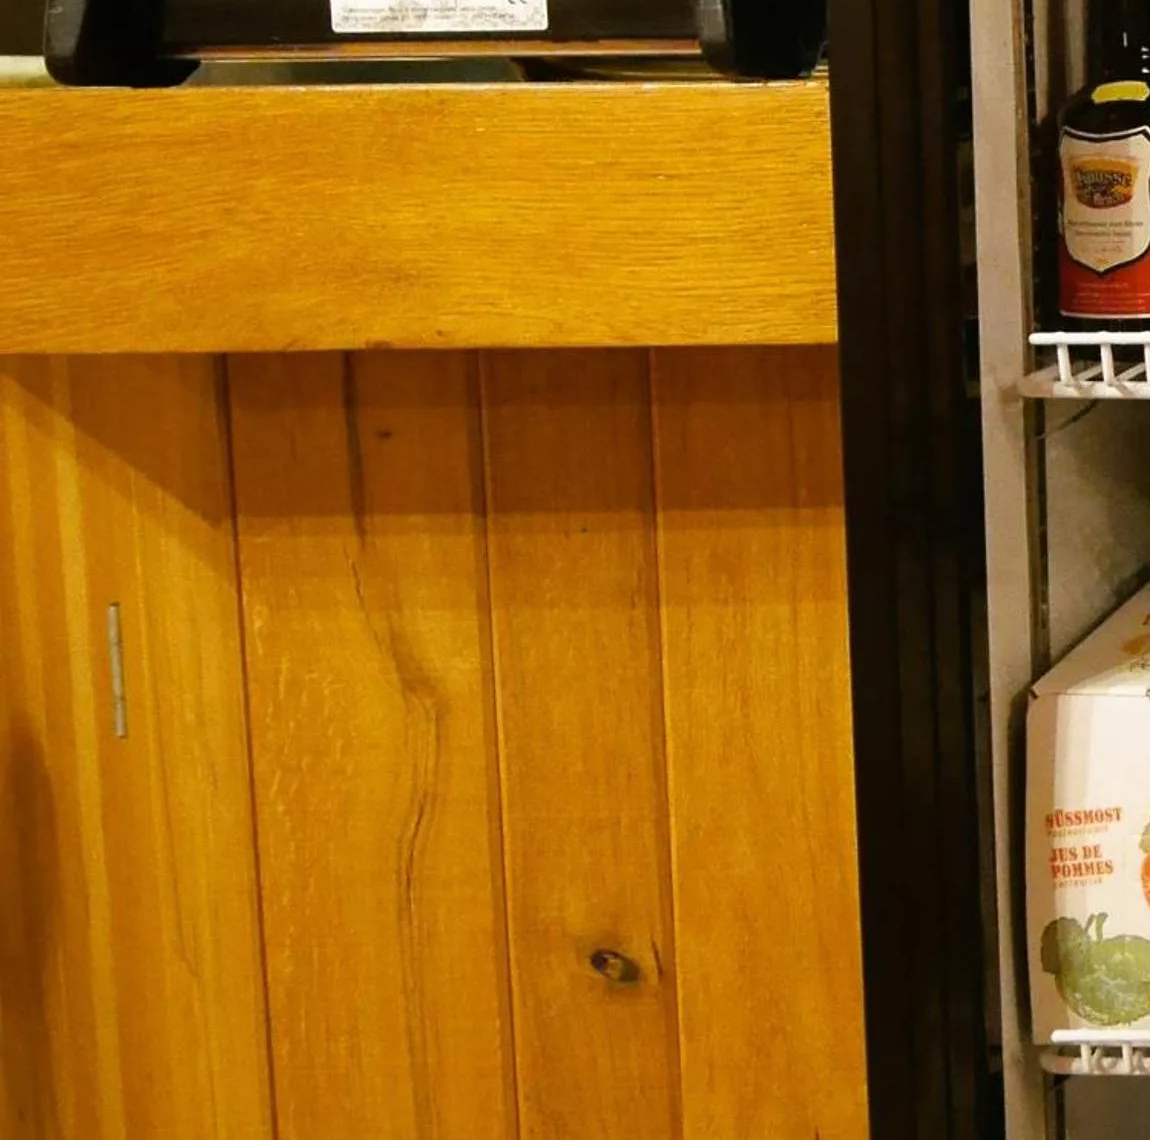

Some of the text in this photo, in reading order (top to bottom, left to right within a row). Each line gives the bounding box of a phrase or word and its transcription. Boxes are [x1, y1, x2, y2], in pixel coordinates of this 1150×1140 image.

[1050, 845, 1102, 863] JUS DE
[1051, 860, 1114, 878] POMMES
